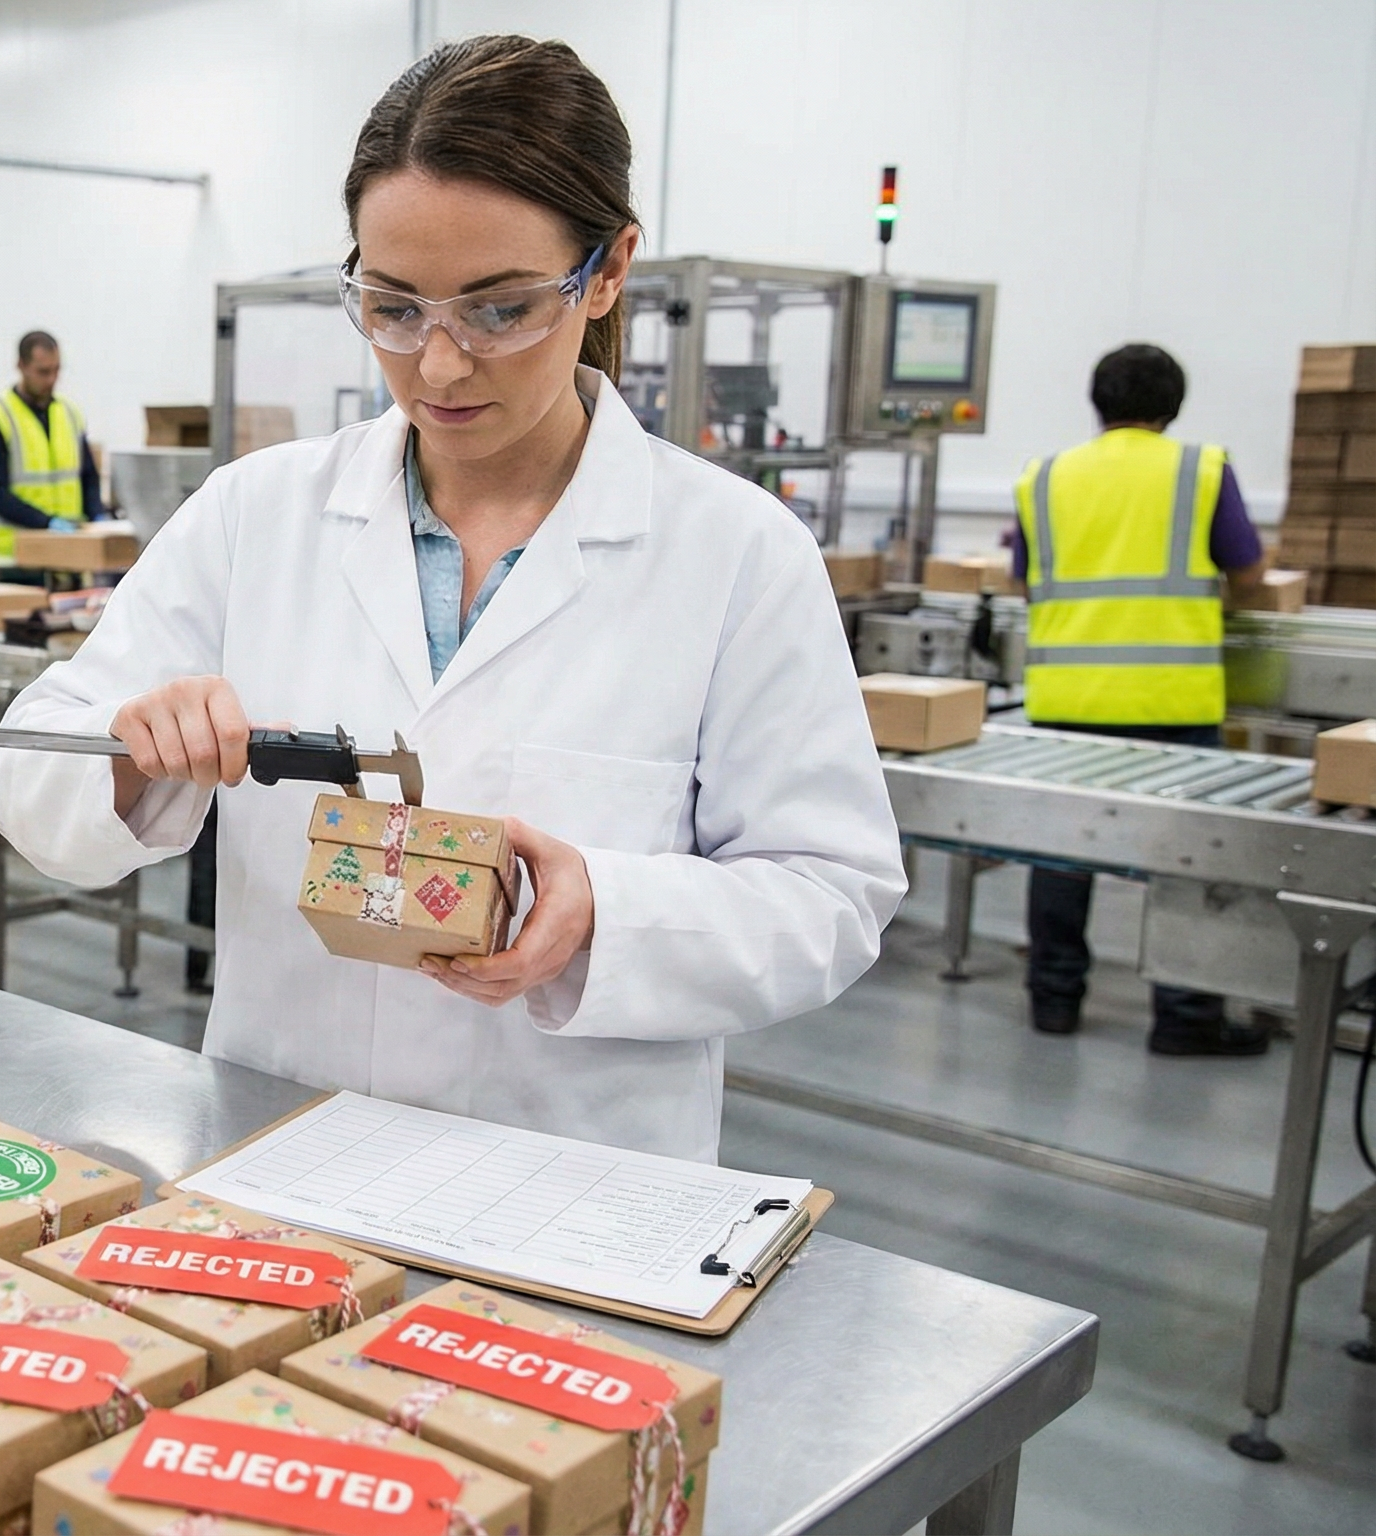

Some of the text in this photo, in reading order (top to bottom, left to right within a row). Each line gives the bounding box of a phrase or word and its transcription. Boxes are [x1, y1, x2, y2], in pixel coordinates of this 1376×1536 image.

[99, 1242, 315, 1287] REJECTED
[396, 1323, 632, 1405] REJECTED
[142, 1437, 414, 1515] REJECTED
